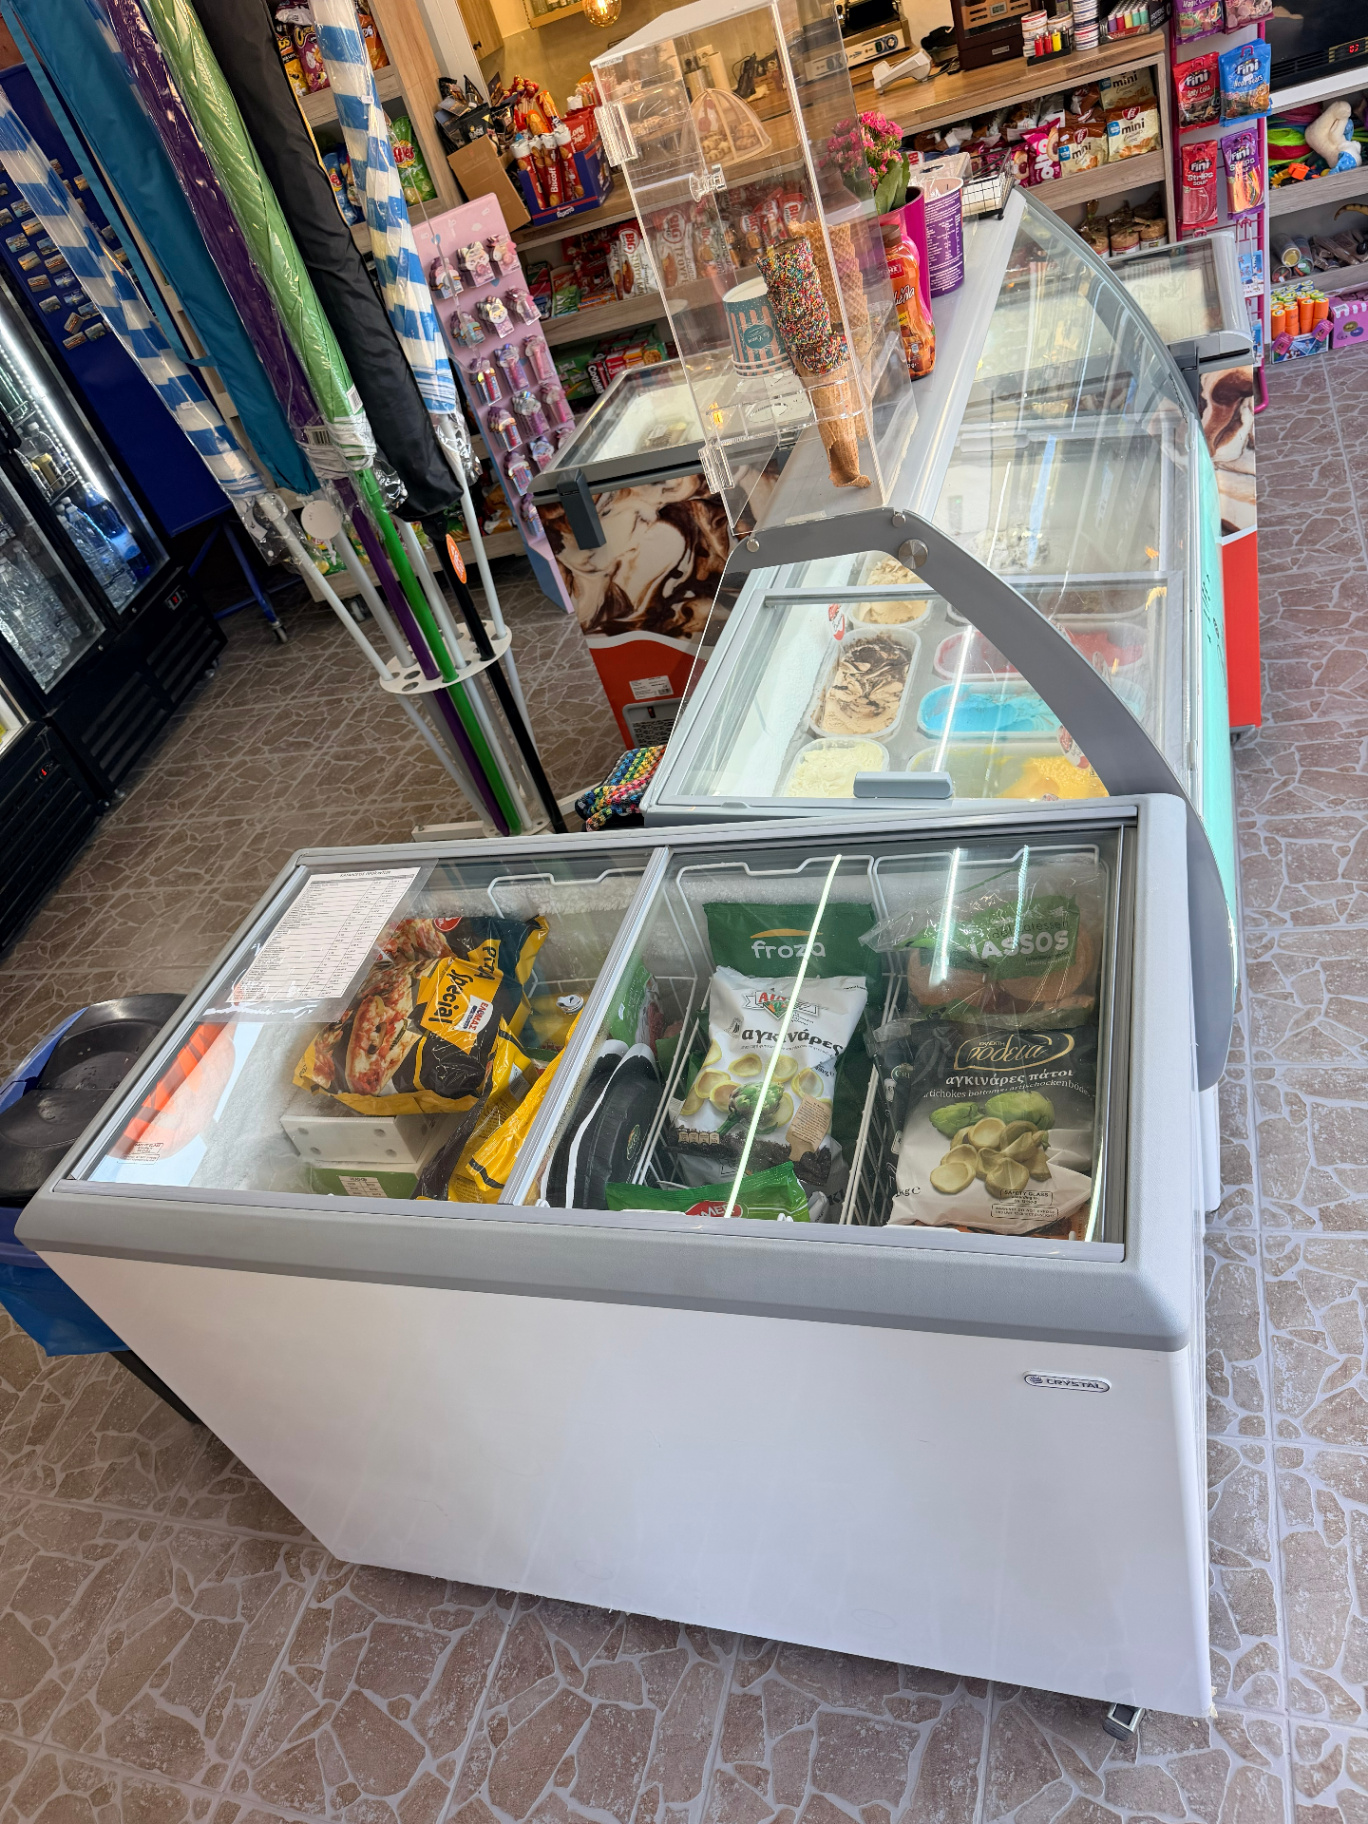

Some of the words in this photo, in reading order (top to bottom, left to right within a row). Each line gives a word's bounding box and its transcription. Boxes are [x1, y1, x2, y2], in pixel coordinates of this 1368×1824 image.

[1112, 71, 1138, 89] mini
[1121, 118, 1145, 135] mini
[1072, 142, 1092, 160] mini
[549, 167, 559, 193] Biscoff
[624, 232, 637, 253] BIG
[751, 940, 826, 959] froza
[428, 968, 474, 1025] Special
[945, 1072, 1025, 1088] αγκινάρες
[1028, 1068, 1073, 1080] πάτοι
[1046, 1377, 1104, 1390] CRYSTAL
